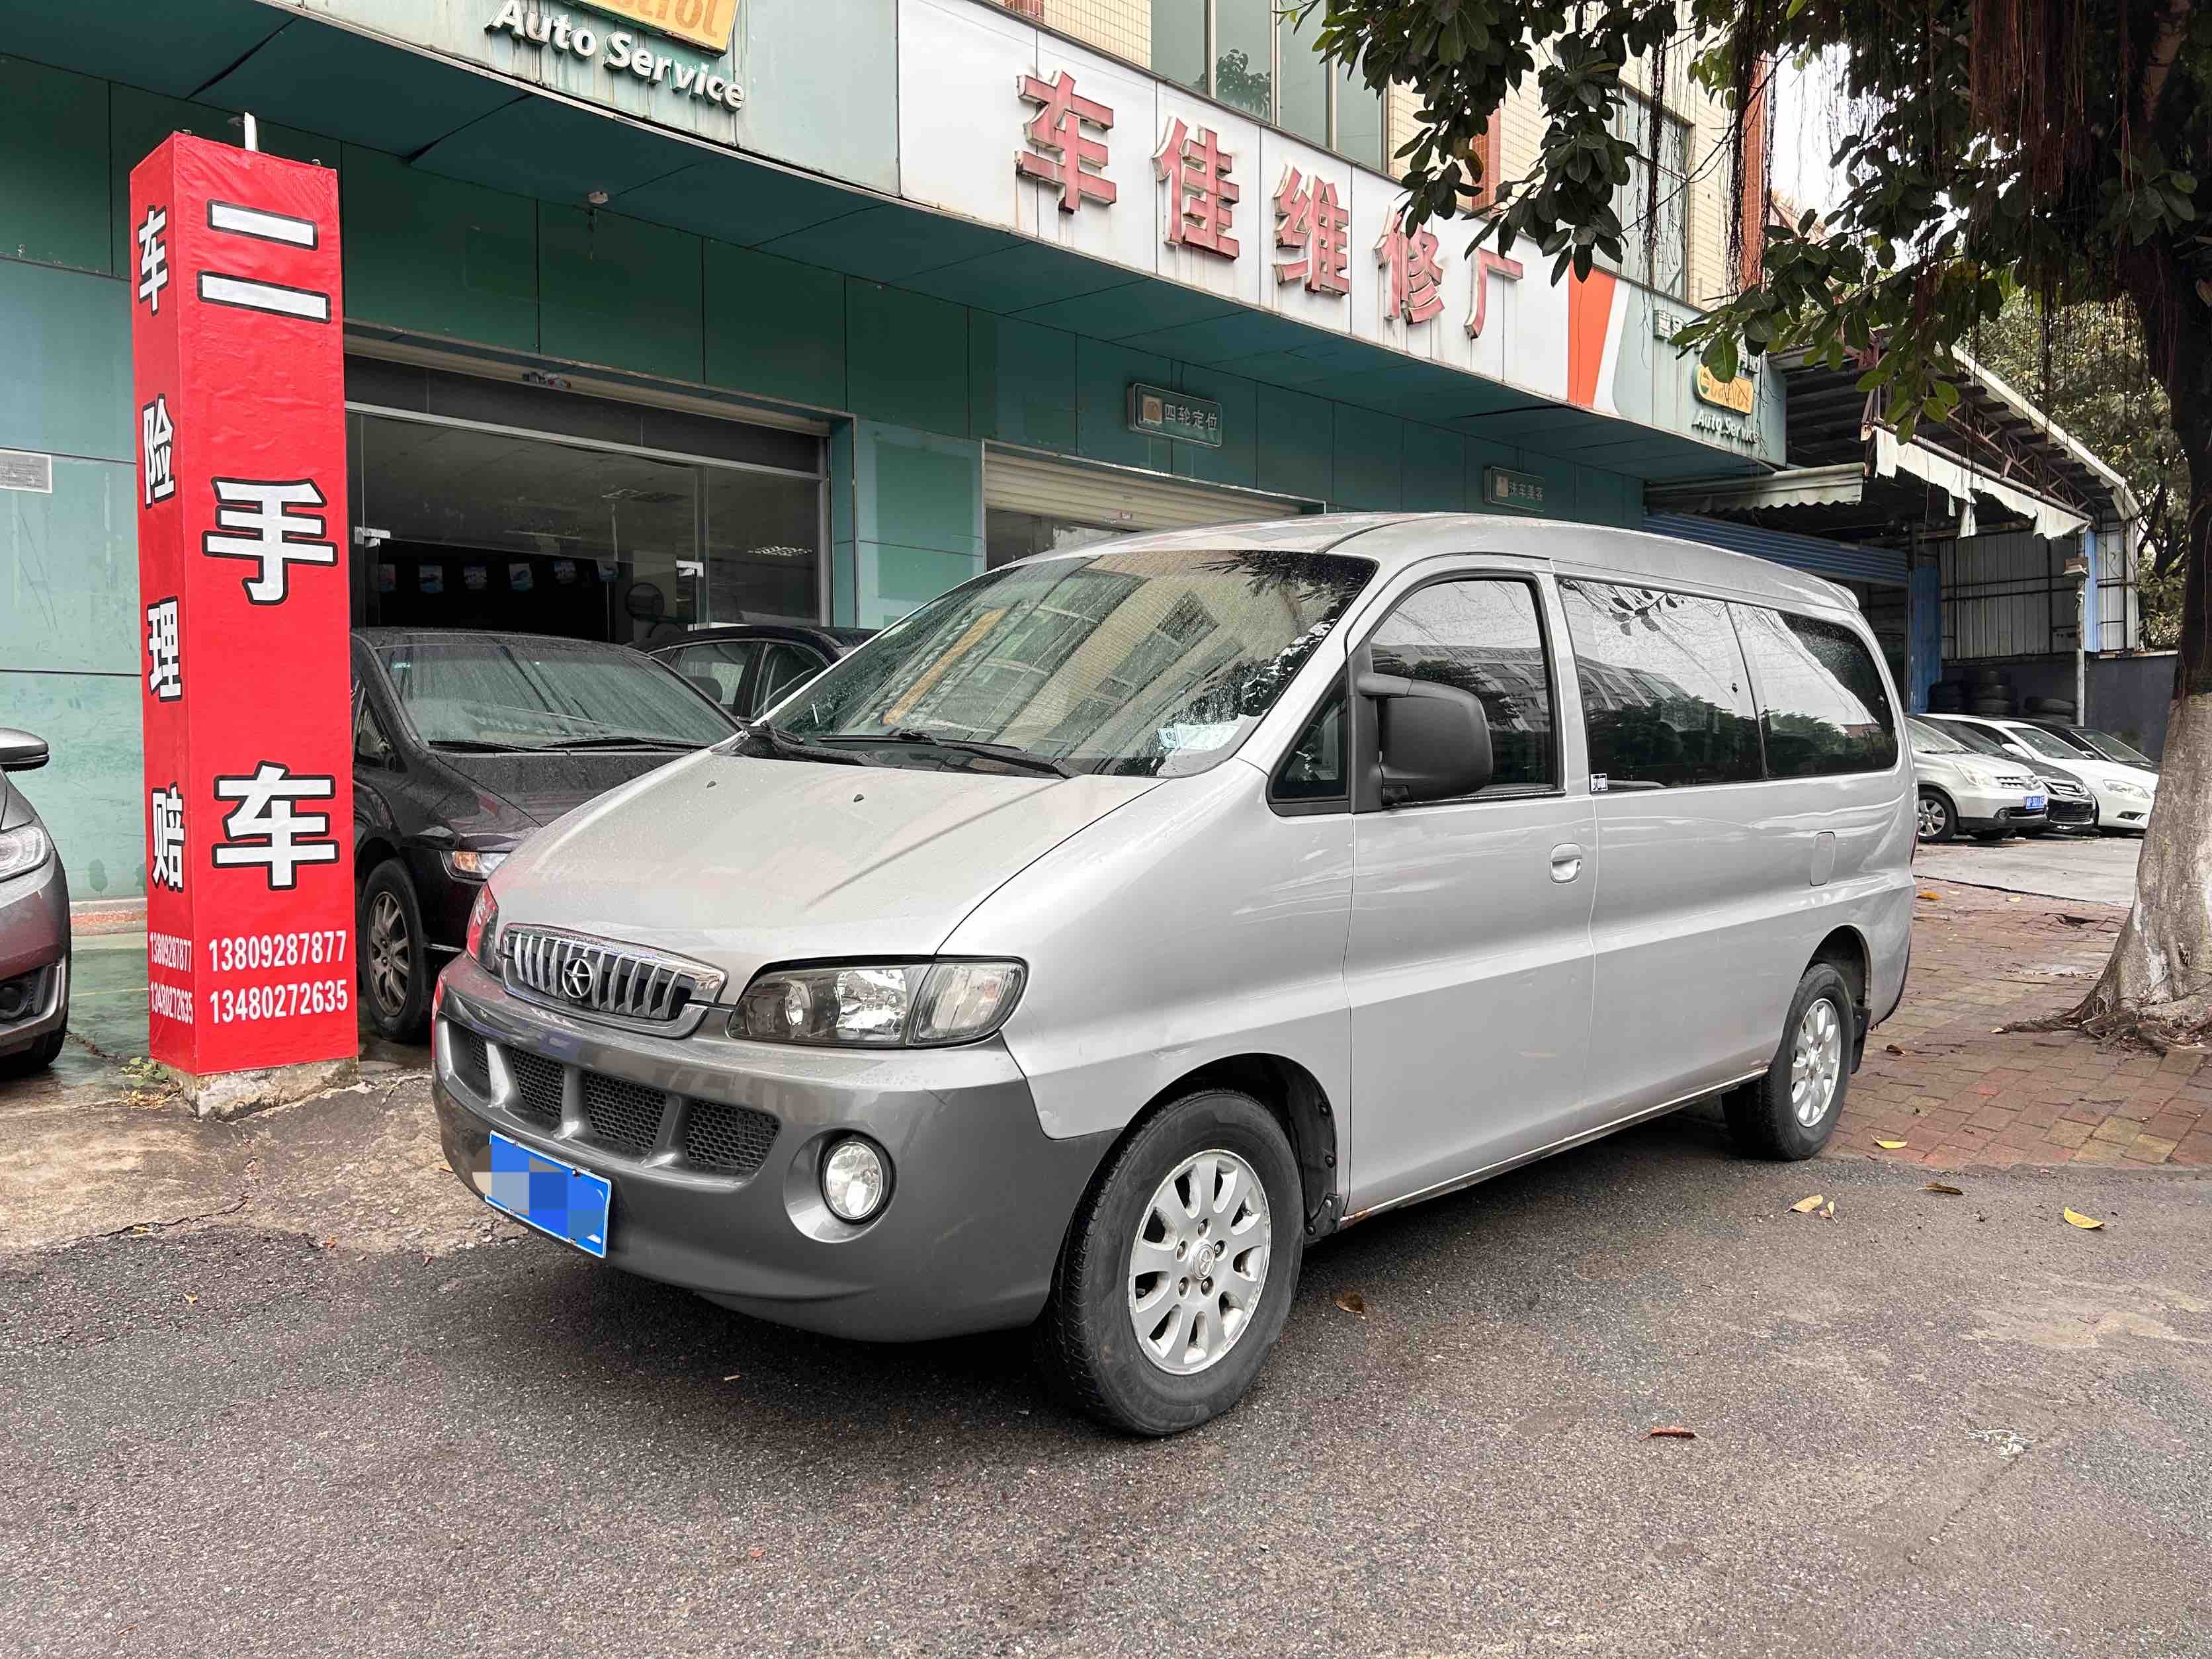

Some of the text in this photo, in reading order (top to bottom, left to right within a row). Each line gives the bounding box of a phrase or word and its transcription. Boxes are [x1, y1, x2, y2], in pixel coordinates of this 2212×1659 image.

[485, 0, 746, 112] Auto Service
[1015, 68, 1524, 339] 车佳维修厂
[1164, 404, 1218, 431] 四轮定位
[1693, 409, 1722, 431] Auto
[138, 205, 185, 891] 车险理赔
[198, 199, 339, 891] 二手车
[149, 931, 192, 973] 13809287877
[209, 930, 347, 972] 13809287877
[150, 981, 193, 1025] 13480272635
[210, 979, 348, 1024] 13480272635
